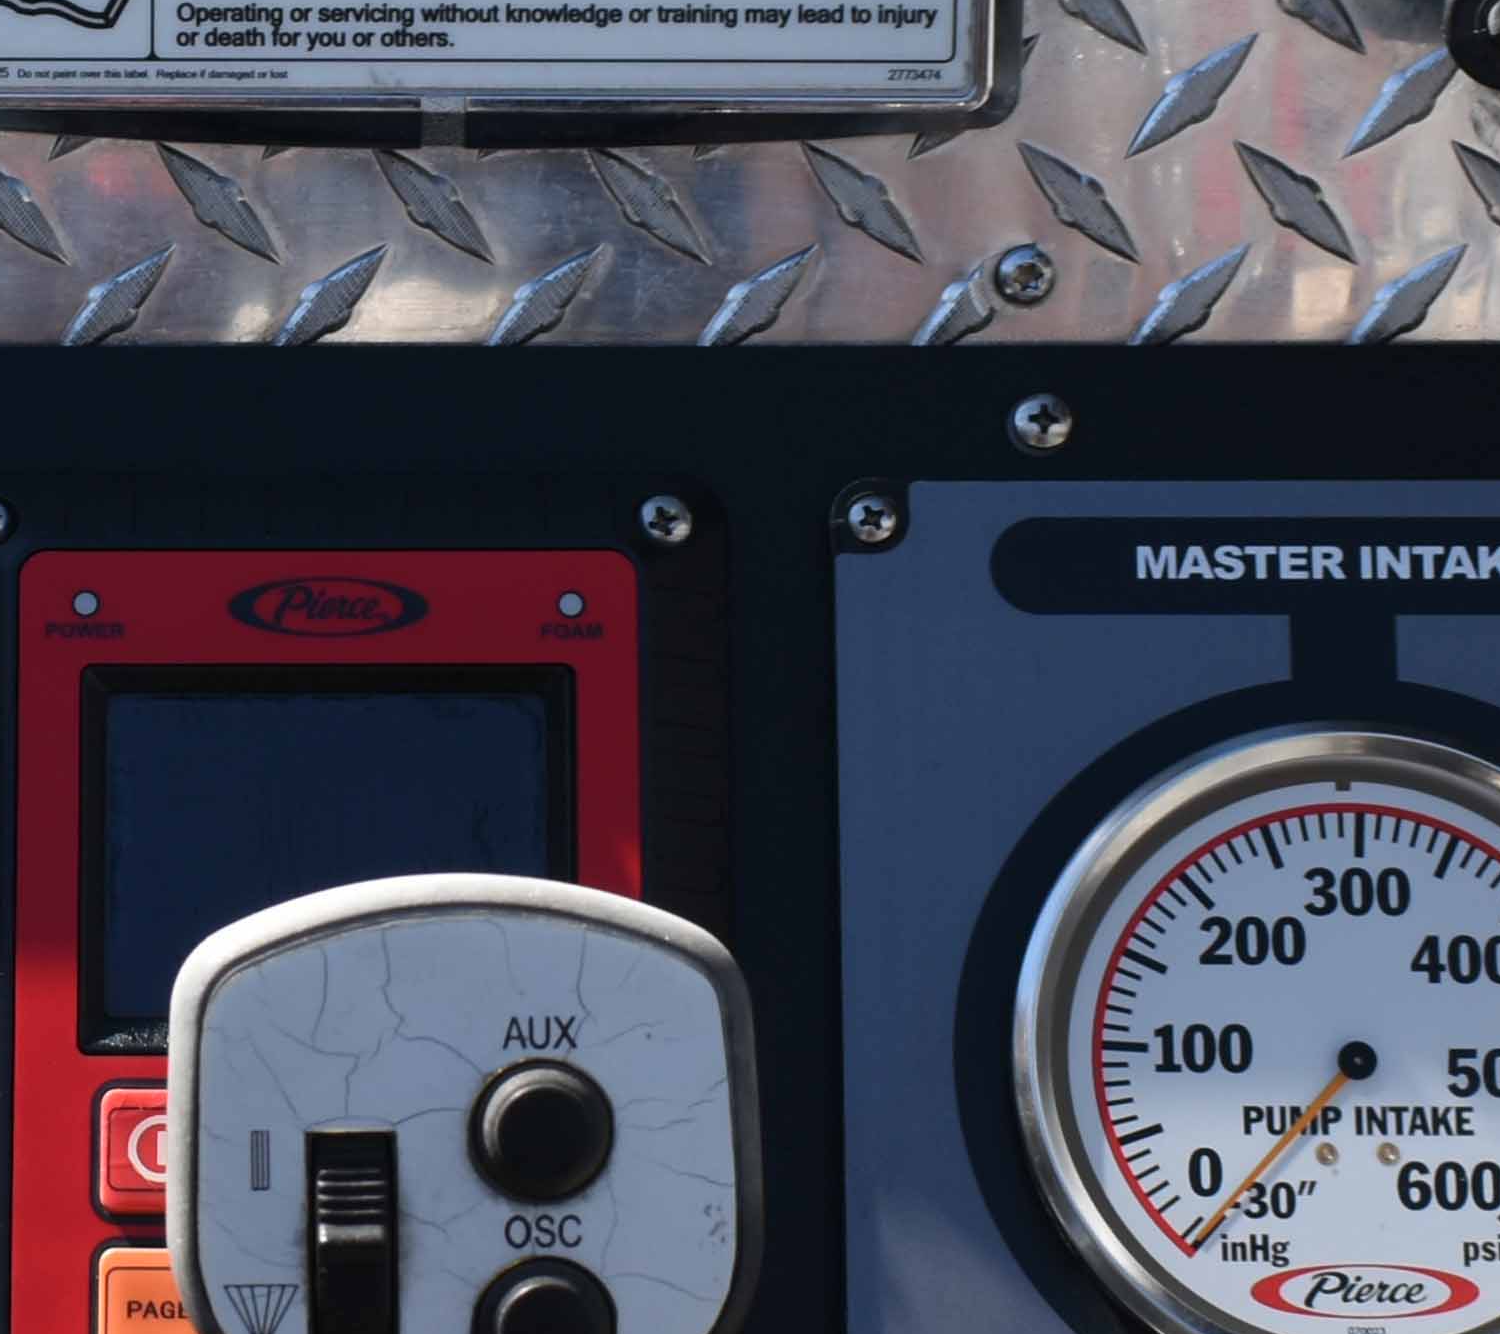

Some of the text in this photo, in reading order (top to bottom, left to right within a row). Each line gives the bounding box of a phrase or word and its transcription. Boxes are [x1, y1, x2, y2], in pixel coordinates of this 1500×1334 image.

[1137, 545, 1346, 580] MASTER
[273, 581, 379, 627] Pierce
[45, 618, 125, 639] POWER
[1303, 867, 1411, 917] 300
[1199, 917, 1306, 967] 200
[503, 1016, 577, 1052] AUX
[1153, 1024, 1253, 1074] 100
[1243, 1107, 1474, 1137] PUMP INTAKE
[1189, 1149, 1223, 1197] 0
[504, 1210, 582, 1254] OSC
[1221, 1237, 1290, 1267] inHg
[1305, 1272, 1429, 1308] Pierce
